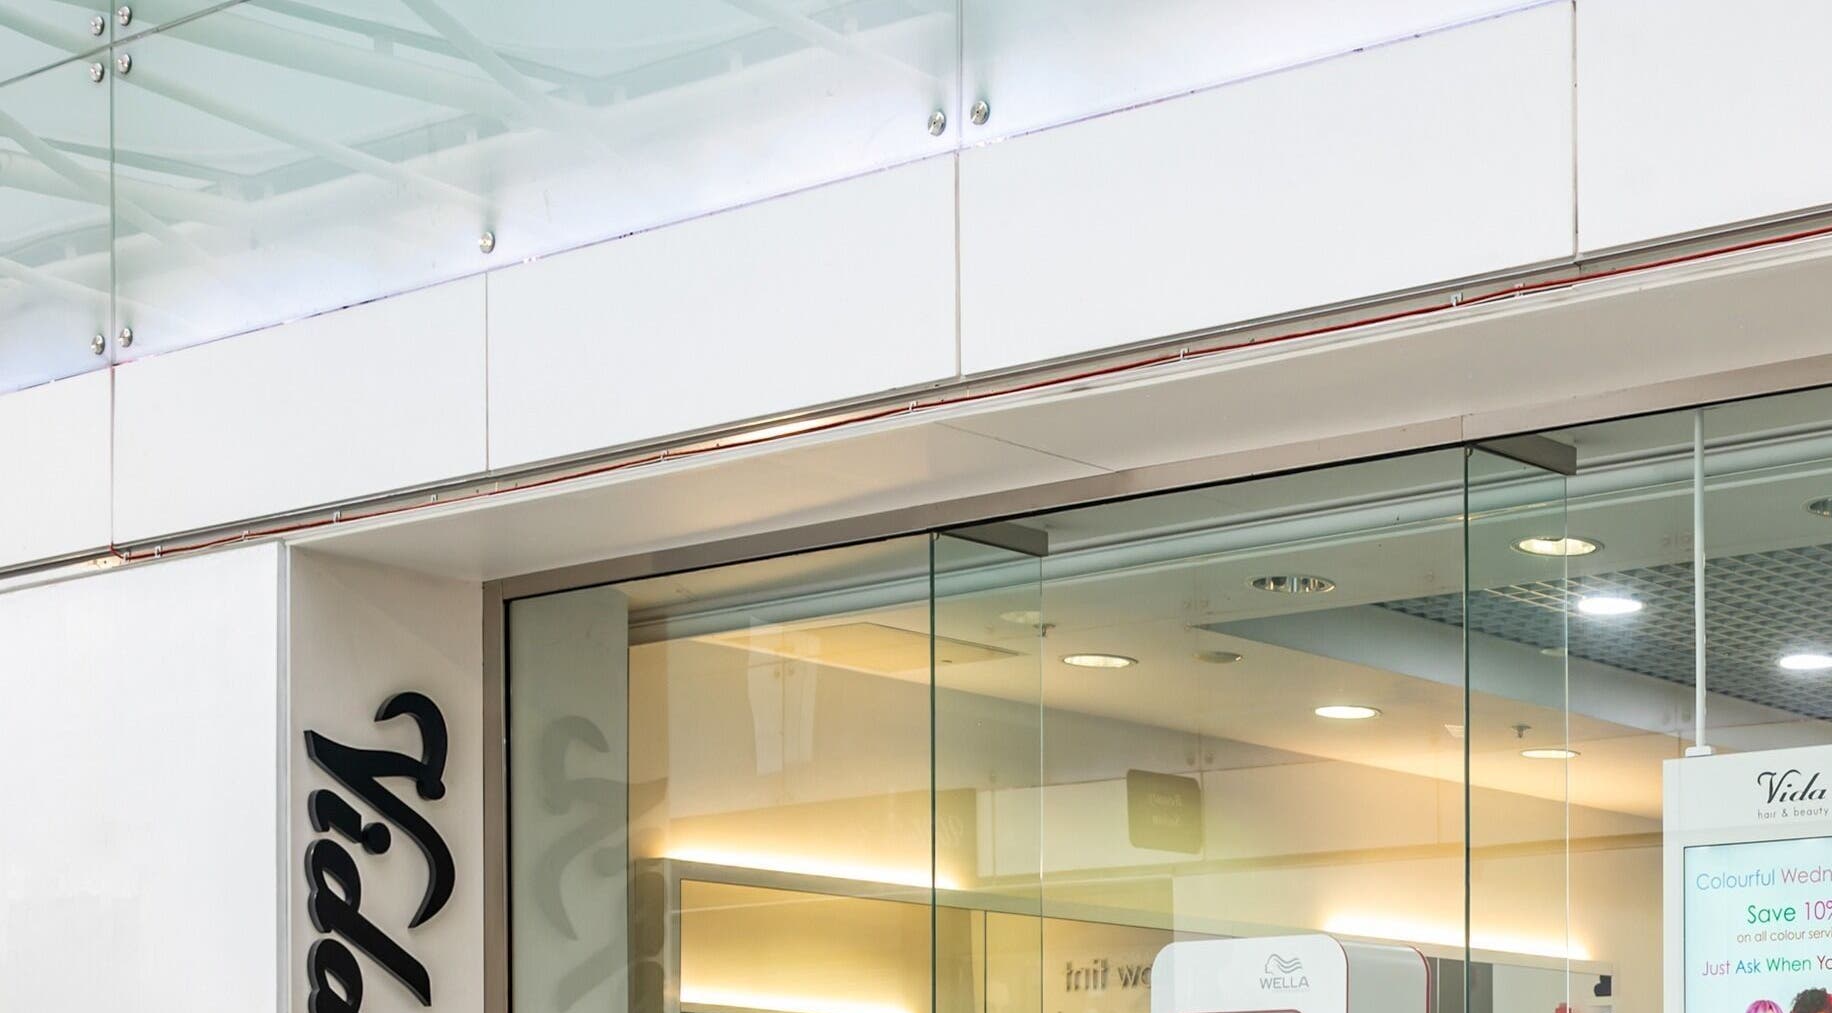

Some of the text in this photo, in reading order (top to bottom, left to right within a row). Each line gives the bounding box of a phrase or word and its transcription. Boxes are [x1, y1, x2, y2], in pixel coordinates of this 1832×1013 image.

[1757, 769, 1827, 804] Vida
[1757, 808, 1776, 819] hair
[1793, 806, 1829, 817] beauty
[1696, 869, 1776, 891] Colourful
[1747, 903, 1796, 924] Save
[1736, 933, 1751, 945] on
[1754, 931, 1768, 942] all
[1769, 930, 1806, 942] colour
[1702, 960, 1730, 976] Just
[1735, 958, 1761, 974] Ask
[1766, 956, 1812, 972] When
[1260, 975, 1310, 990] WELLA
